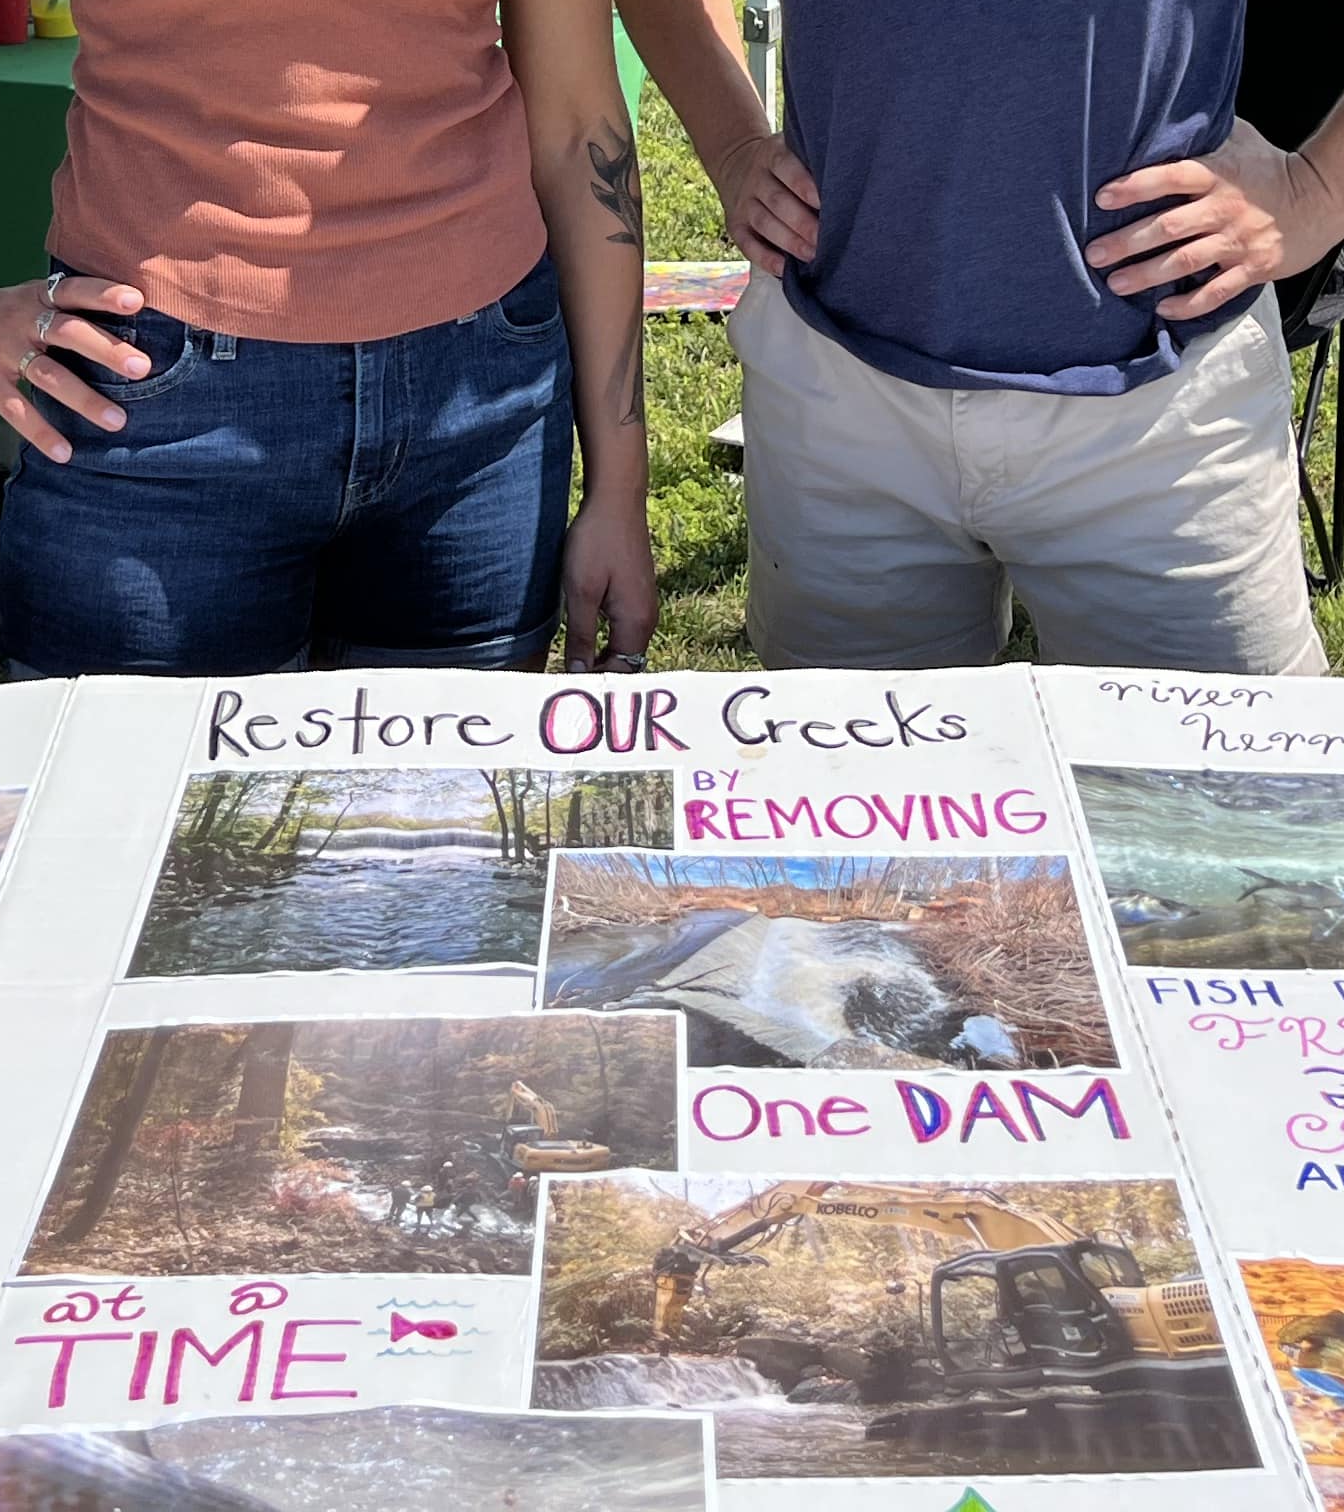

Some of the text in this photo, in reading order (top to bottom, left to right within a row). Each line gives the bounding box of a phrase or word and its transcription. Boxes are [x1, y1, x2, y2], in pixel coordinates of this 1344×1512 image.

[1099, 680, 1273, 707] river
[207, 686, 968, 758] Restore OUR Creeks
[693, 769, 739, 791] BY
[684, 789, 1047, 840] REMOVING
[1148, 978, 1284, 1007] FISH
[692, 1077, 1132, 1144] One DAM
[816, 1203, 878, 1219] KOBELCO
[43, 1281, 289, 1323] at a
[15, 1320, 362, 1408] TIME
